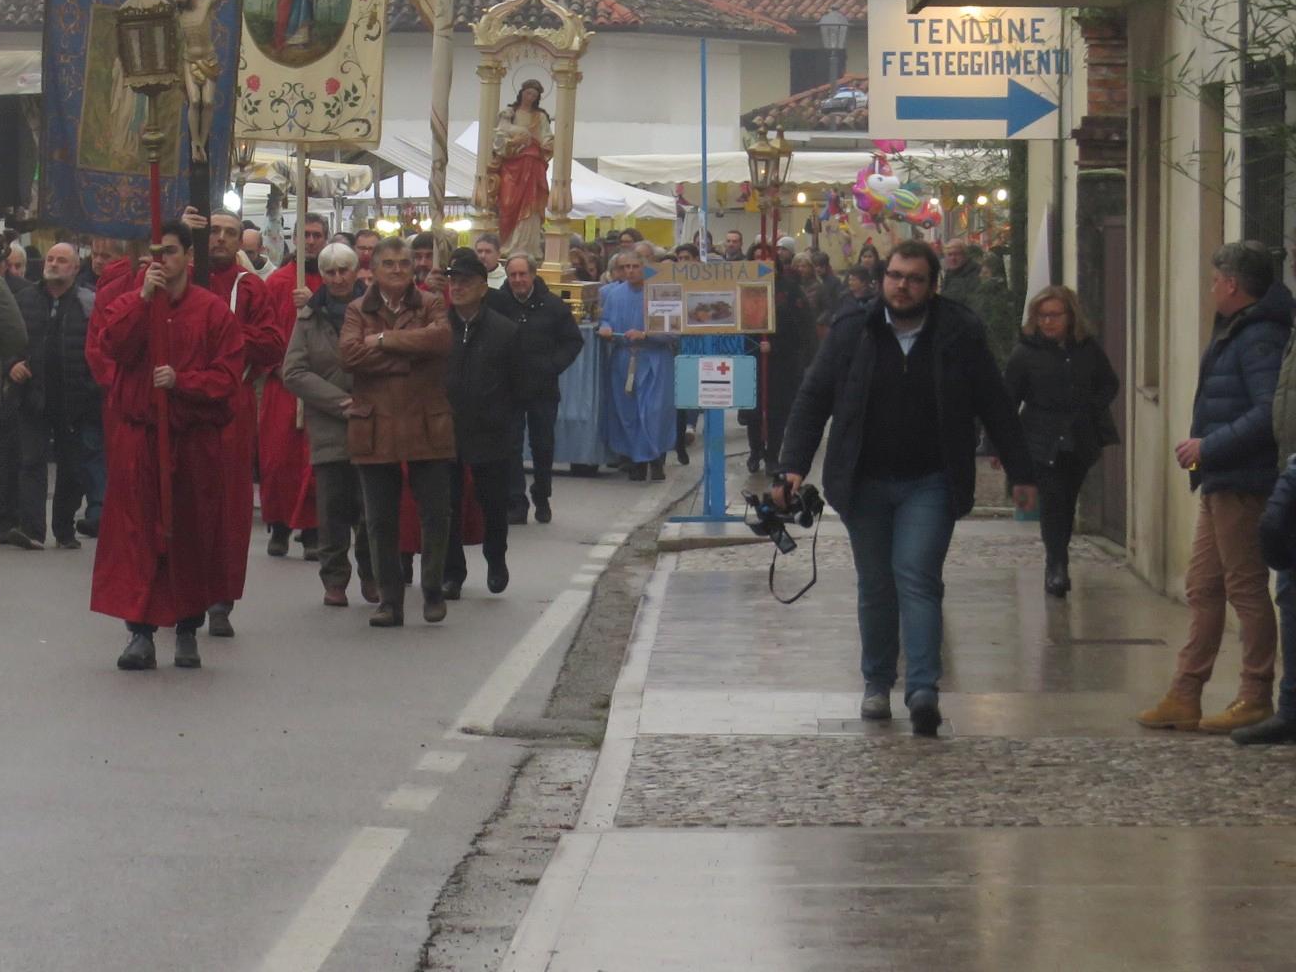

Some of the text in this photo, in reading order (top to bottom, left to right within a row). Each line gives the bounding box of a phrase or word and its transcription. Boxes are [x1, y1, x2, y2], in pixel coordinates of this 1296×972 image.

[907, 17, 1046, 45] TENDONE
[882, 49, 1071, 77] FESTEGGIAMENTI
[671, 260, 749, 282] MOSTRA
